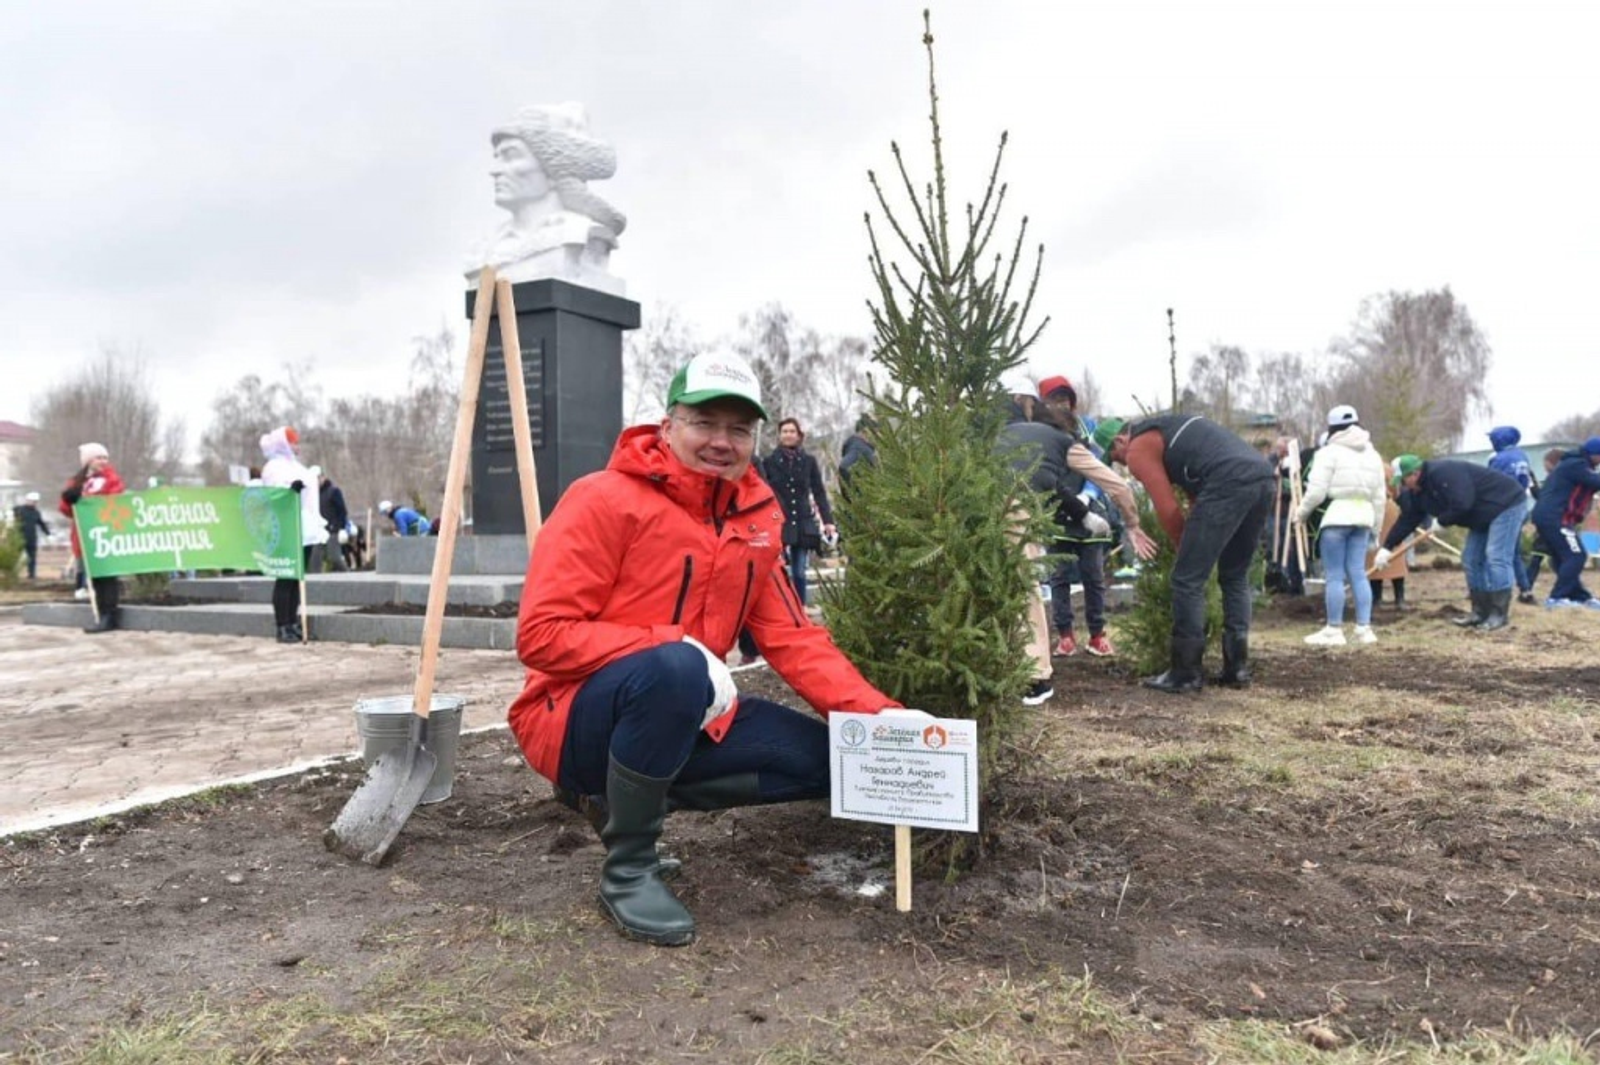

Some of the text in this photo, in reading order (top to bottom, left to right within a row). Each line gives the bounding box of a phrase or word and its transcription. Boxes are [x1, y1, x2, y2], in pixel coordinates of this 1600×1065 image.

[131, 495, 220, 528] Зелёная
[88, 525, 213, 569] Башкирия
[907, 766, 946, 780] Андрей
